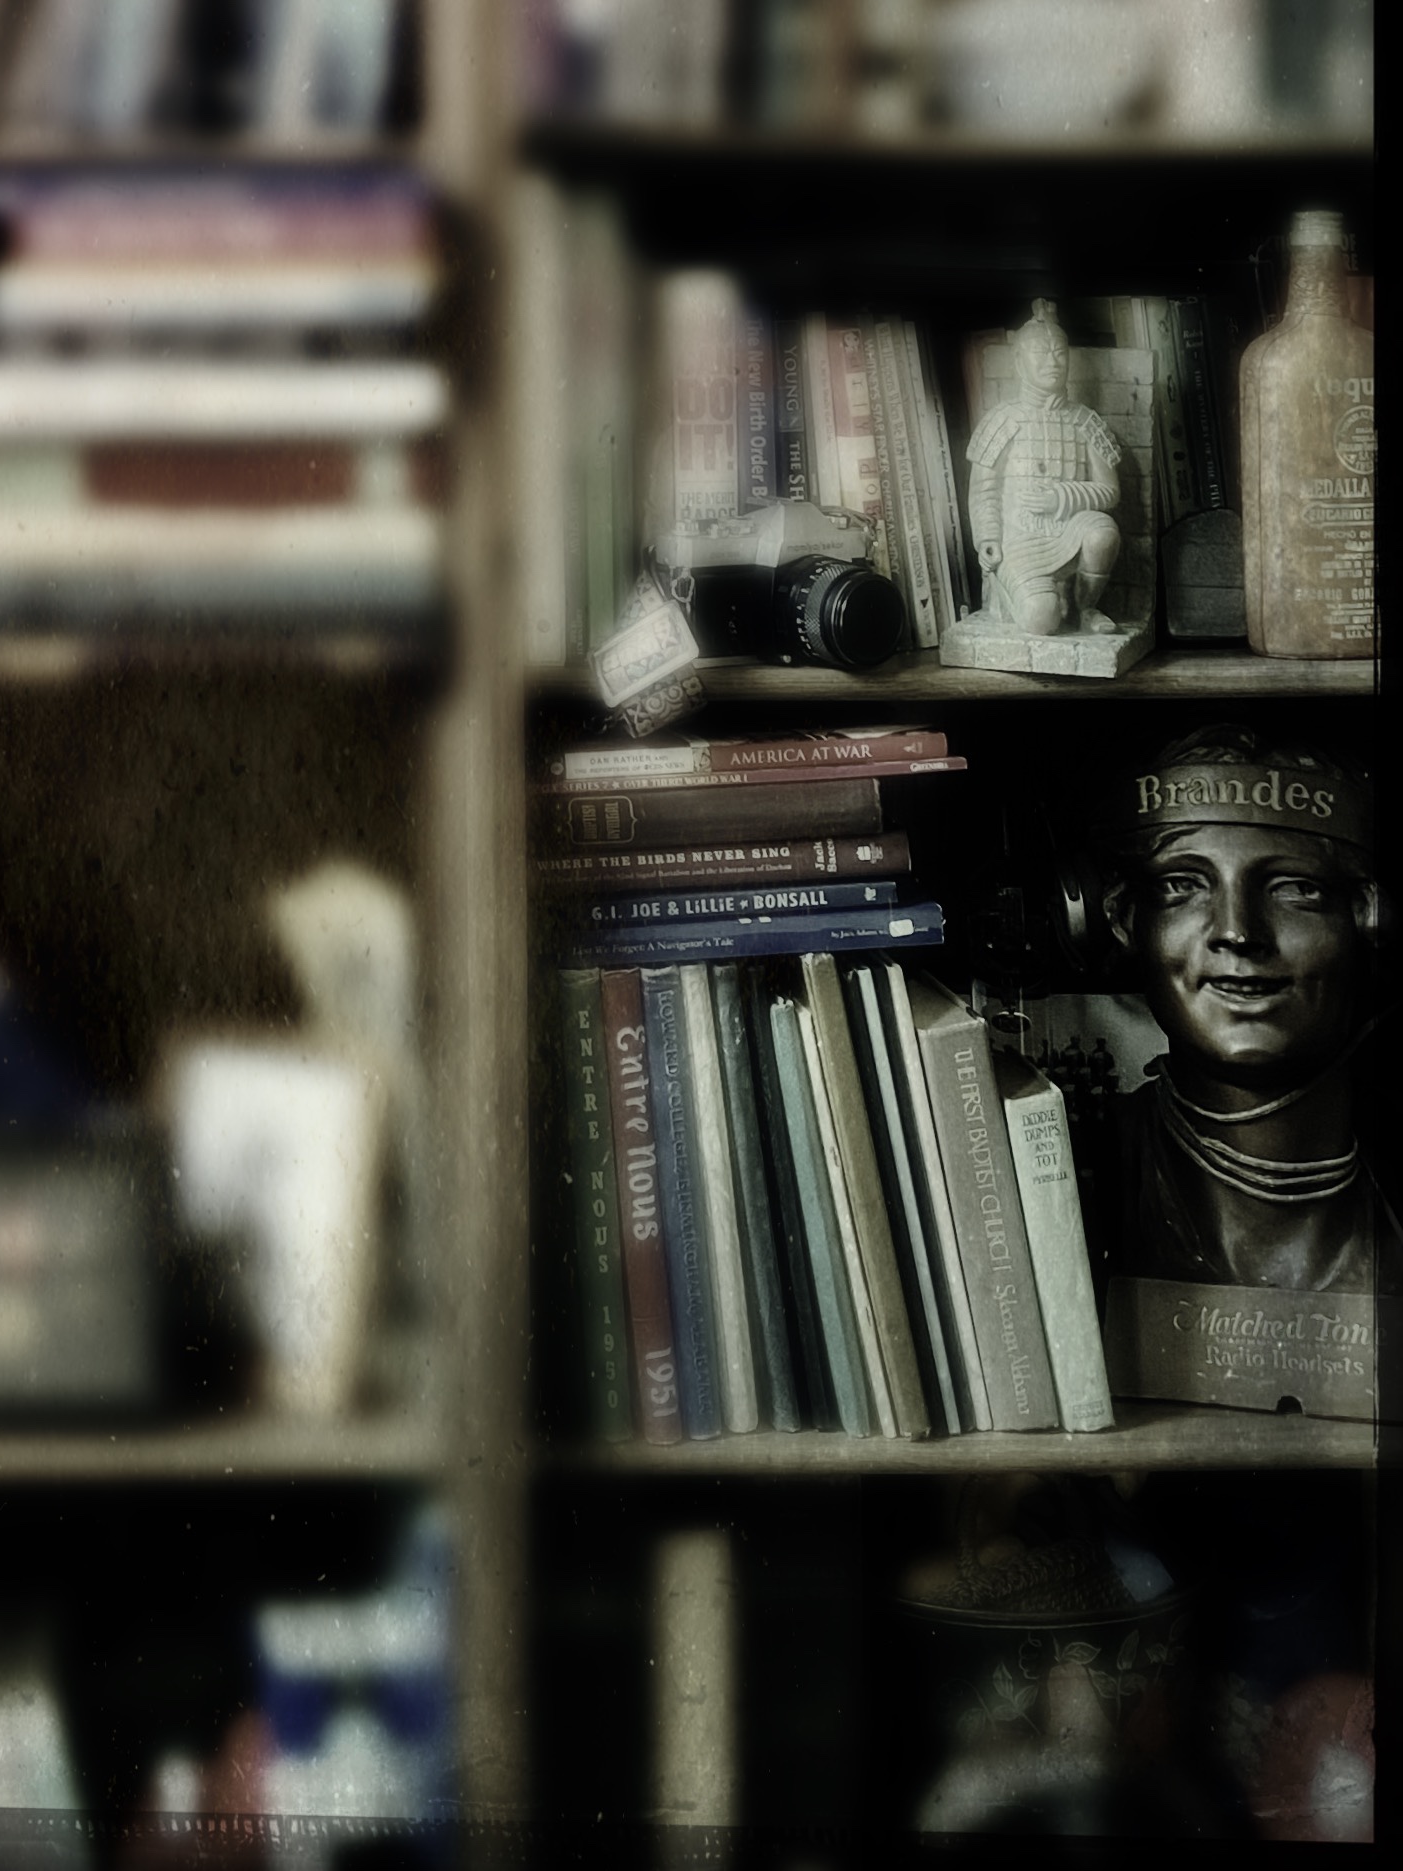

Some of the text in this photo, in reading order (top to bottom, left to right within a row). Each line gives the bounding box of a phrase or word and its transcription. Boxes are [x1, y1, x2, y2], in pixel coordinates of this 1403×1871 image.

[748, 350, 764, 386] New
[782, 345, 800, 411] YOUNG
[677, 377, 734, 421] DO
[748, 392, 765, 431] Birth
[887, 393, 902, 420] When
[871, 403, 884, 431] STAR
[892, 421, 904, 436] We
[679, 424, 734, 470] IT!
[750, 436, 768, 481] Order
[788, 440, 801, 469] THE
[875, 434, 890, 473] FINDER
[893, 437, 908, 457] Pray
[897, 457, 910, 472] for
[899, 473, 913, 491] Our
[880, 478, 895, 521] CHARLES
[590, 756, 609, 765] DAN
[613, 754, 652, 764] RATHER
[730, 744, 873, 766] AMERICA AT WAR
[563, 780, 597, 791] SERIES
[683, 775, 719, 786] WORLD
[719, 774, 742, 784] WAR
[1136, 769, 1334, 818] Brandes
[537, 846, 790, 870] WHERE THE BIRDS NEVER SING
[812, 841, 825, 870] Jack
[590, 904, 622, 921] G.I.
[630, 900, 661, 918] JOE
[666, 900, 679, 916] &
[753, 889, 828, 910] BONSALL
[712, 936, 734, 947] Tale
[657, 990, 679, 1076] HOWARD
[952, 1047, 976, 1081] THE
[959, 1082, 985, 1126] FIRST
[1022, 1109, 1058, 1126] DIDDIE
[1024, 1124, 1061, 1142] DUMPS
[1036, 1141, 1054, 1152] AND
[964, 1127, 997, 1194] BAPTIST
[1035, 1153, 1058, 1168] TOT
[576, 1010, 619, 1409] ENTRE NOUS 1950
[614, 1024, 677, 1419] Entre Nous 1951
[979, 1193, 1014, 1273] CHURCH
[1173, 1301, 1305, 1340] Matched
[1309, 1313, 1375, 1345] Ton
[1206, 1345, 1365, 1376] Radio Headsets
[1007, 1351, 1038, 1415] Alabama
